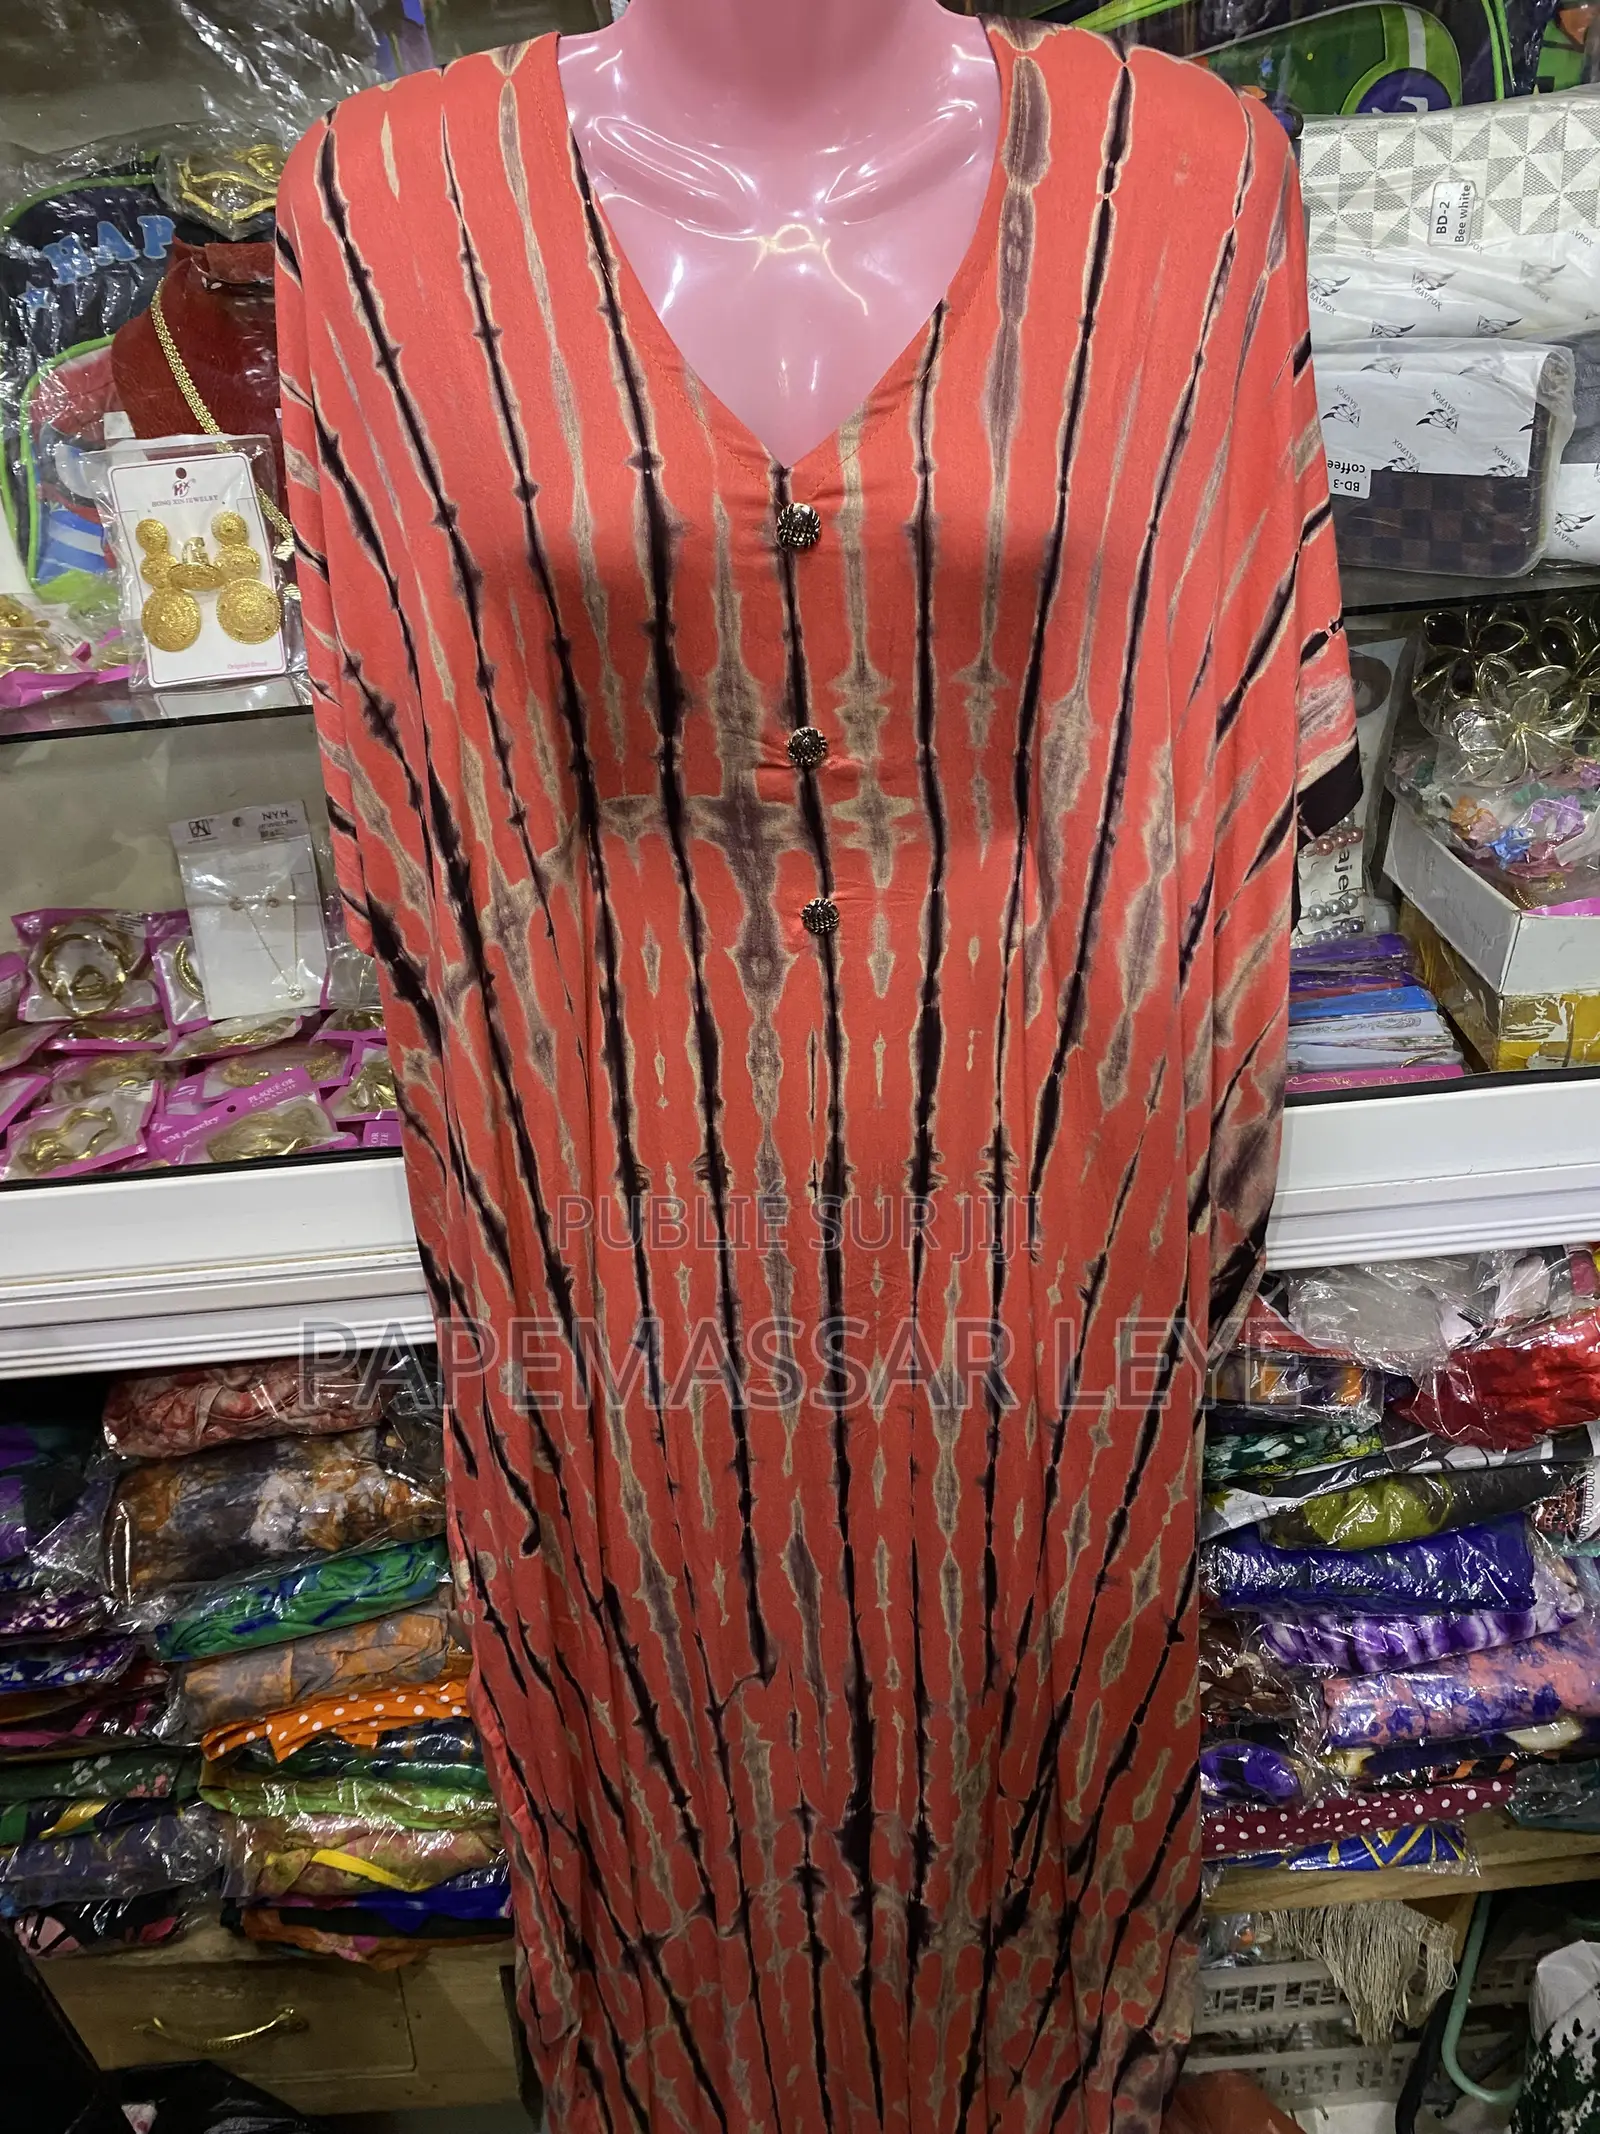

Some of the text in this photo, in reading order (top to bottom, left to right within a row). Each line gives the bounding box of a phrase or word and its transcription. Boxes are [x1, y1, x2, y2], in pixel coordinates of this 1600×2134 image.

[1436, 201, 1450, 234] BD-2
[1454, 185, 1471, 242] Bee white
[1309, 292, 1336, 315] SAVFOX
[1335, 385, 1358, 409] SAVFOX
[1431, 388, 1456, 414] SAVFOX
[1392, 438, 1417, 463] SAVFOX
[1493, 446, 1519, 471] SAVFOX
[1327, 459, 1365, 474] coffee
[1333, 478, 1360, 492] BD-3
[1553, 527, 1580, 549] SAVFOX
[261, 810, 288, 820] NYH
